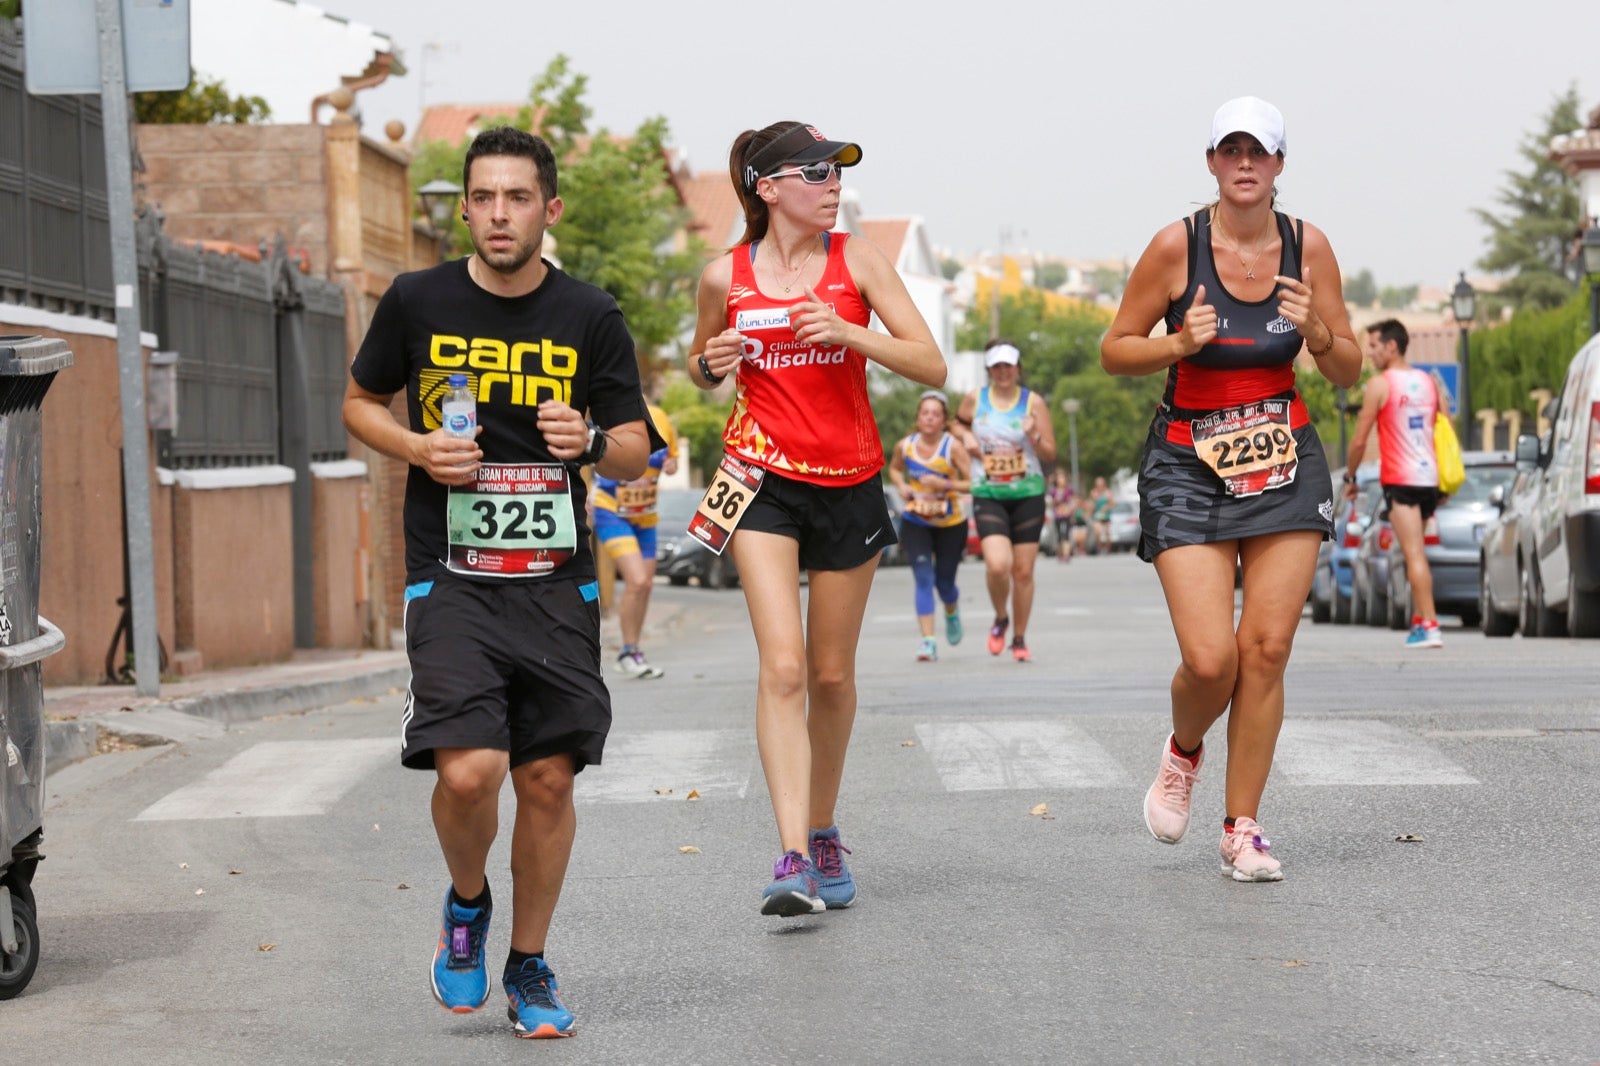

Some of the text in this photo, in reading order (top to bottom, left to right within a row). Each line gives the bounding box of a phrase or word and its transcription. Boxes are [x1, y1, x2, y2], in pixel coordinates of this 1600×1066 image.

[430, 334, 577, 377] carb
[1212, 428, 1291, 470] 2299
[477, 482, 547, 492] DIPUTACIÓN CRUZCAMPO
[479, 468, 500, 480] GRAN
[503, 468, 530, 480] PREMIO
[531, 468, 540, 480] DE
[541, 468, 562, 480] FONDO
[471, 500, 556, 539] 325
